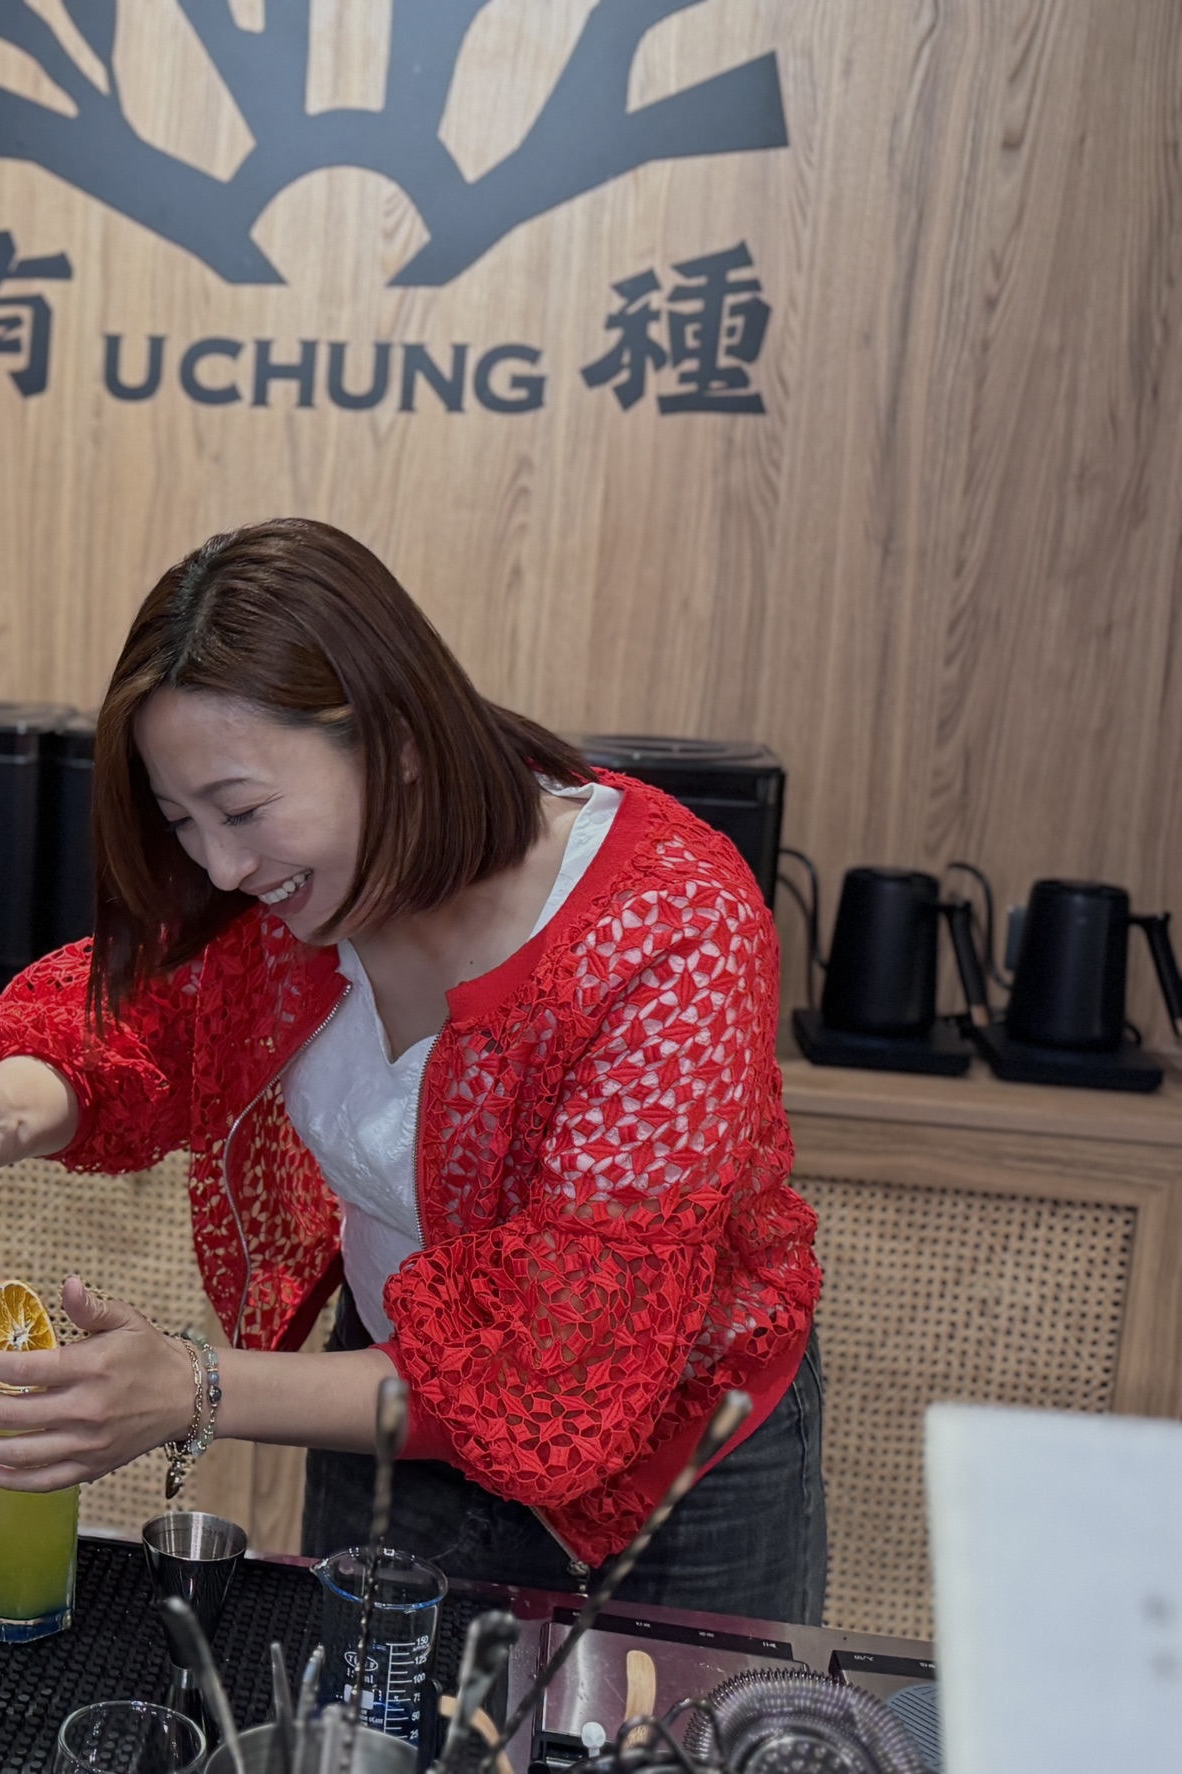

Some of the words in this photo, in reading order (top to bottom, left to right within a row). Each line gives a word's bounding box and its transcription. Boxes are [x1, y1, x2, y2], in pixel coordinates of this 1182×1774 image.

[102, 333, 547, 415] UCHUNG
[579, 240, 772, 416] 種
[417, 1636, 429, 1645] 150
[415, 1655, 428, 1665] 125
[413, 1672, 426, 1684] 100
